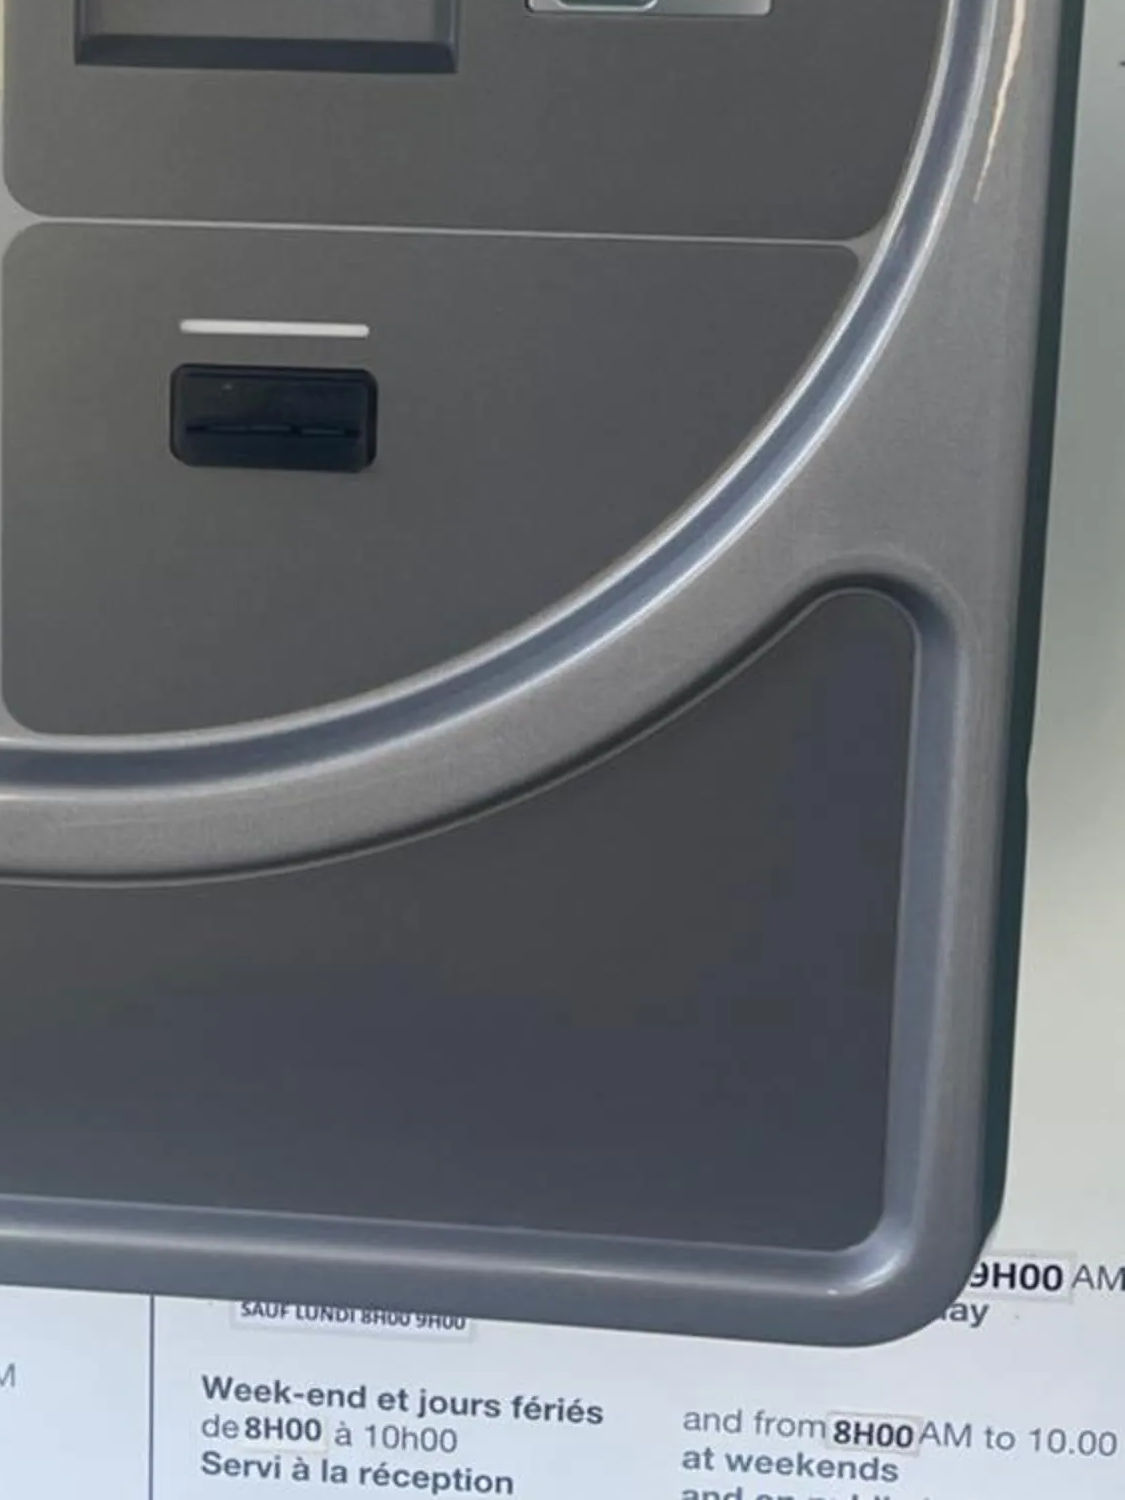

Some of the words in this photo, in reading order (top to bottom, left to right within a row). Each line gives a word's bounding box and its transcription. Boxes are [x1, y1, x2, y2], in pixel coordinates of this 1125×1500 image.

[970, 1261, 1064, 1291] 9H00
[1071, 1264, 1125, 1291] AM
[941, 1303, 990, 1328] ay
[201, 1374, 367, 1409] Week-end
[377, 1388, 410, 1413] et
[417, 1388, 502, 1419] jours
[512, 1394, 605, 1425] fériés
[201, 1413, 240, 1439] de
[244, 1416, 323, 1442] 8H00
[334, 1420, 353, 1448] à
[364, 1424, 459, 1454] 10h00
[682, 1409, 743, 1435] and
[753, 1410, 826, 1440] from
[833, 1419, 914, 1449] 8H00
[919, 1420, 972, 1449] AM
[984, 1426, 1016, 1452] to
[1029, 1428, 1118, 1458] 10.00
[201, 1450, 281, 1479] Servi
[291, 1456, 310, 1482] à
[322, 1457, 348, 1484] la
[359, 1461, 515, 1496] réception
[681, 1447, 715, 1472] at
[725, 1450, 900, 1484] weekends
